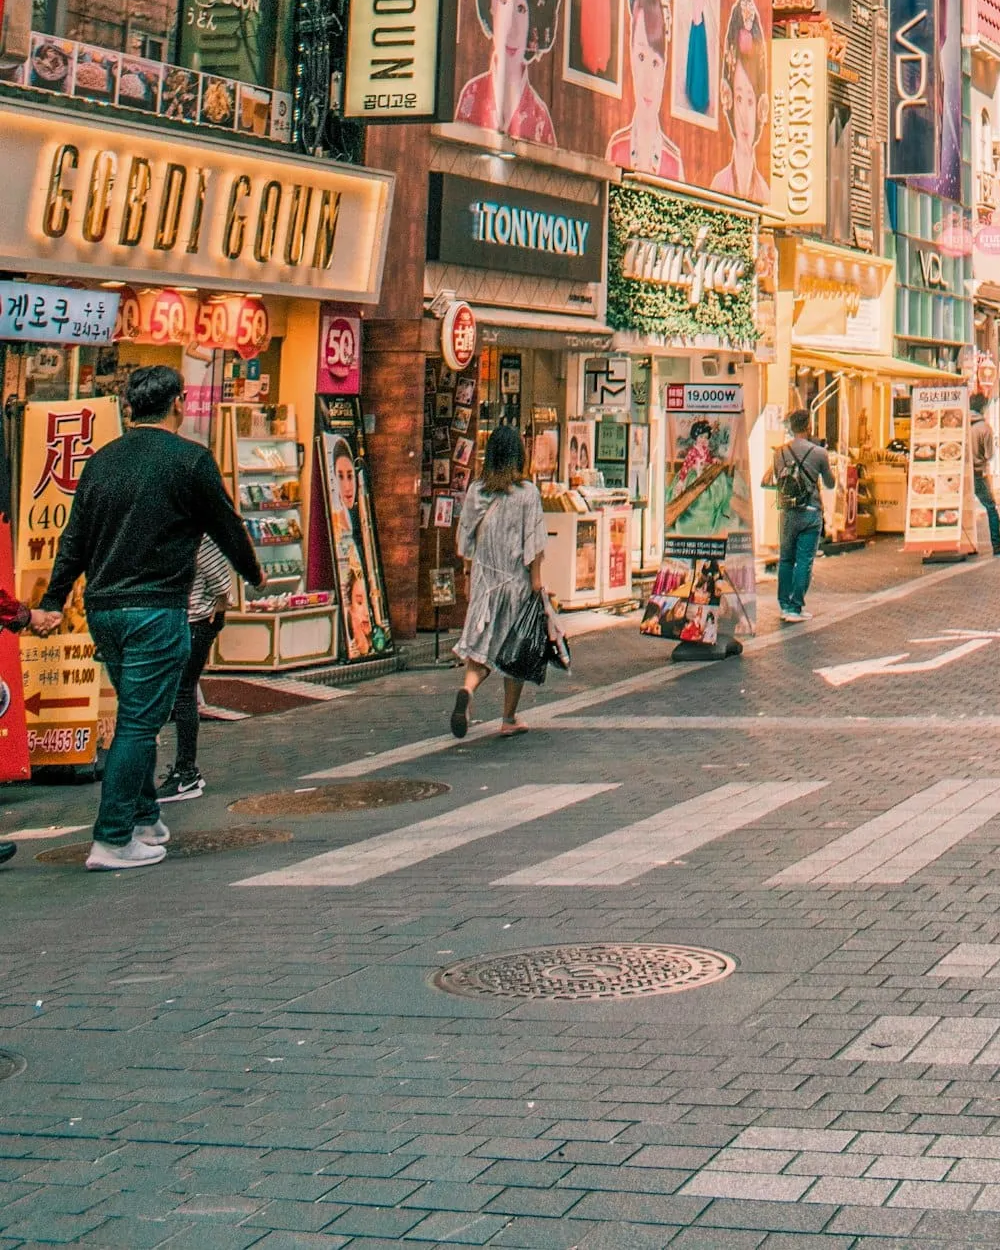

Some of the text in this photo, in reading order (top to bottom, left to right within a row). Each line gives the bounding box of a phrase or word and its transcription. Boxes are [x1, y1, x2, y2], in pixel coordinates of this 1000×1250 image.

[895, 8, 929, 140] VDL
[364, 93, 417, 110] 곱디고운
[788, 49, 814, 215] SKINFOOD
[222, 175, 342, 270] GOUN
[8, 293, 69, 334] 겐로쿠
[152, 302, 186, 341] 50
[198, 305, 228, 343] 50
[237, 308, 267, 346] 50
[326, 329, 354, 366] 50
[34, 408, 95, 498] 足
[75, 727, 91, 751] 3F
